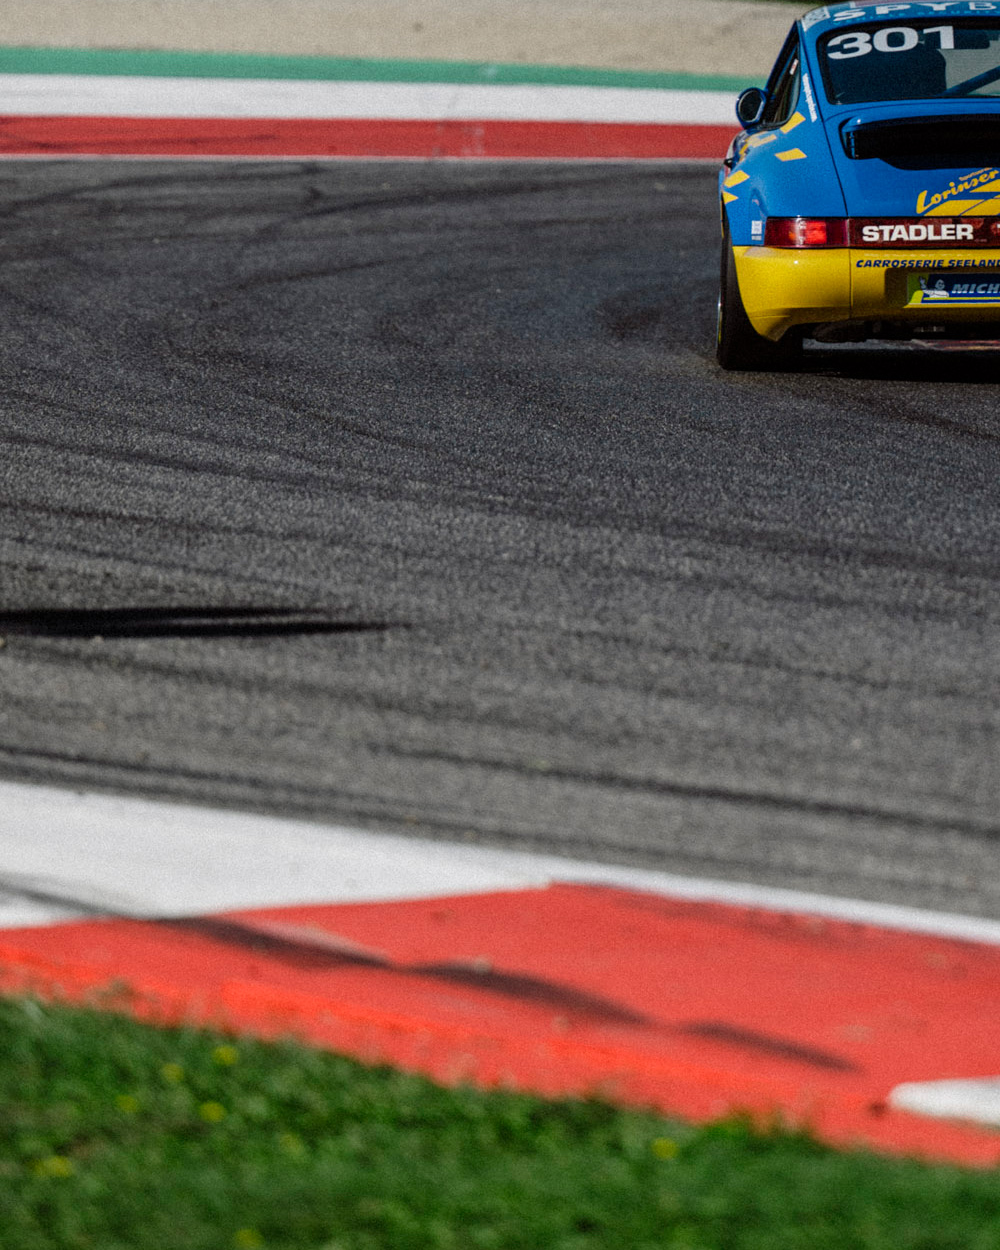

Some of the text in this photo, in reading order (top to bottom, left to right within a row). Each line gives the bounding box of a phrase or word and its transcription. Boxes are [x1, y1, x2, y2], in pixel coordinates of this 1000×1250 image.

[826, 25, 955, 60] 301
[916, 169, 999, 215] Lorinser
[862, 224, 974, 242] STADLER
[856, 259, 945, 268] CARROSSERIE
